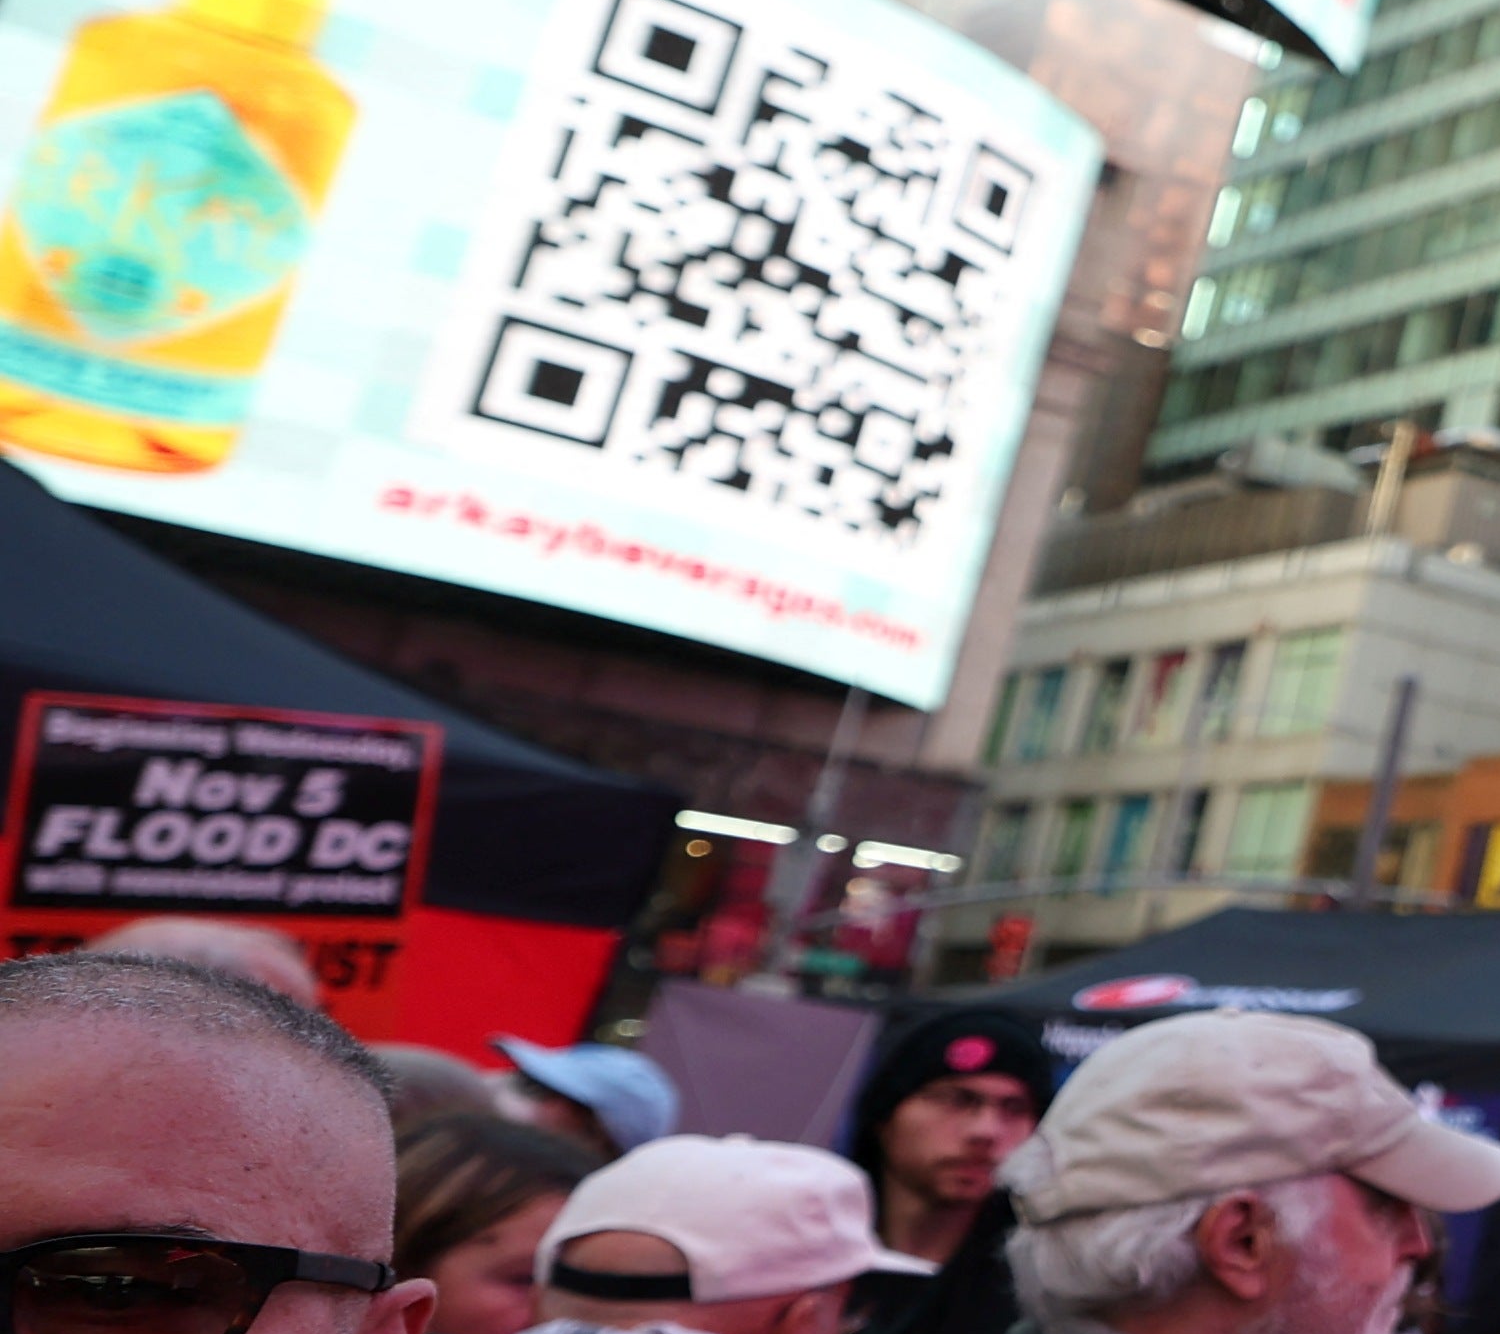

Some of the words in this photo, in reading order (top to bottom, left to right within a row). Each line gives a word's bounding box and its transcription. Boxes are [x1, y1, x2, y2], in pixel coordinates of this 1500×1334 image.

[132, 757, 286, 813] Nov
[292, 768, 348, 818] 5
[34, 804, 299, 866] FLOOD
[307, 819, 411, 871] DC
